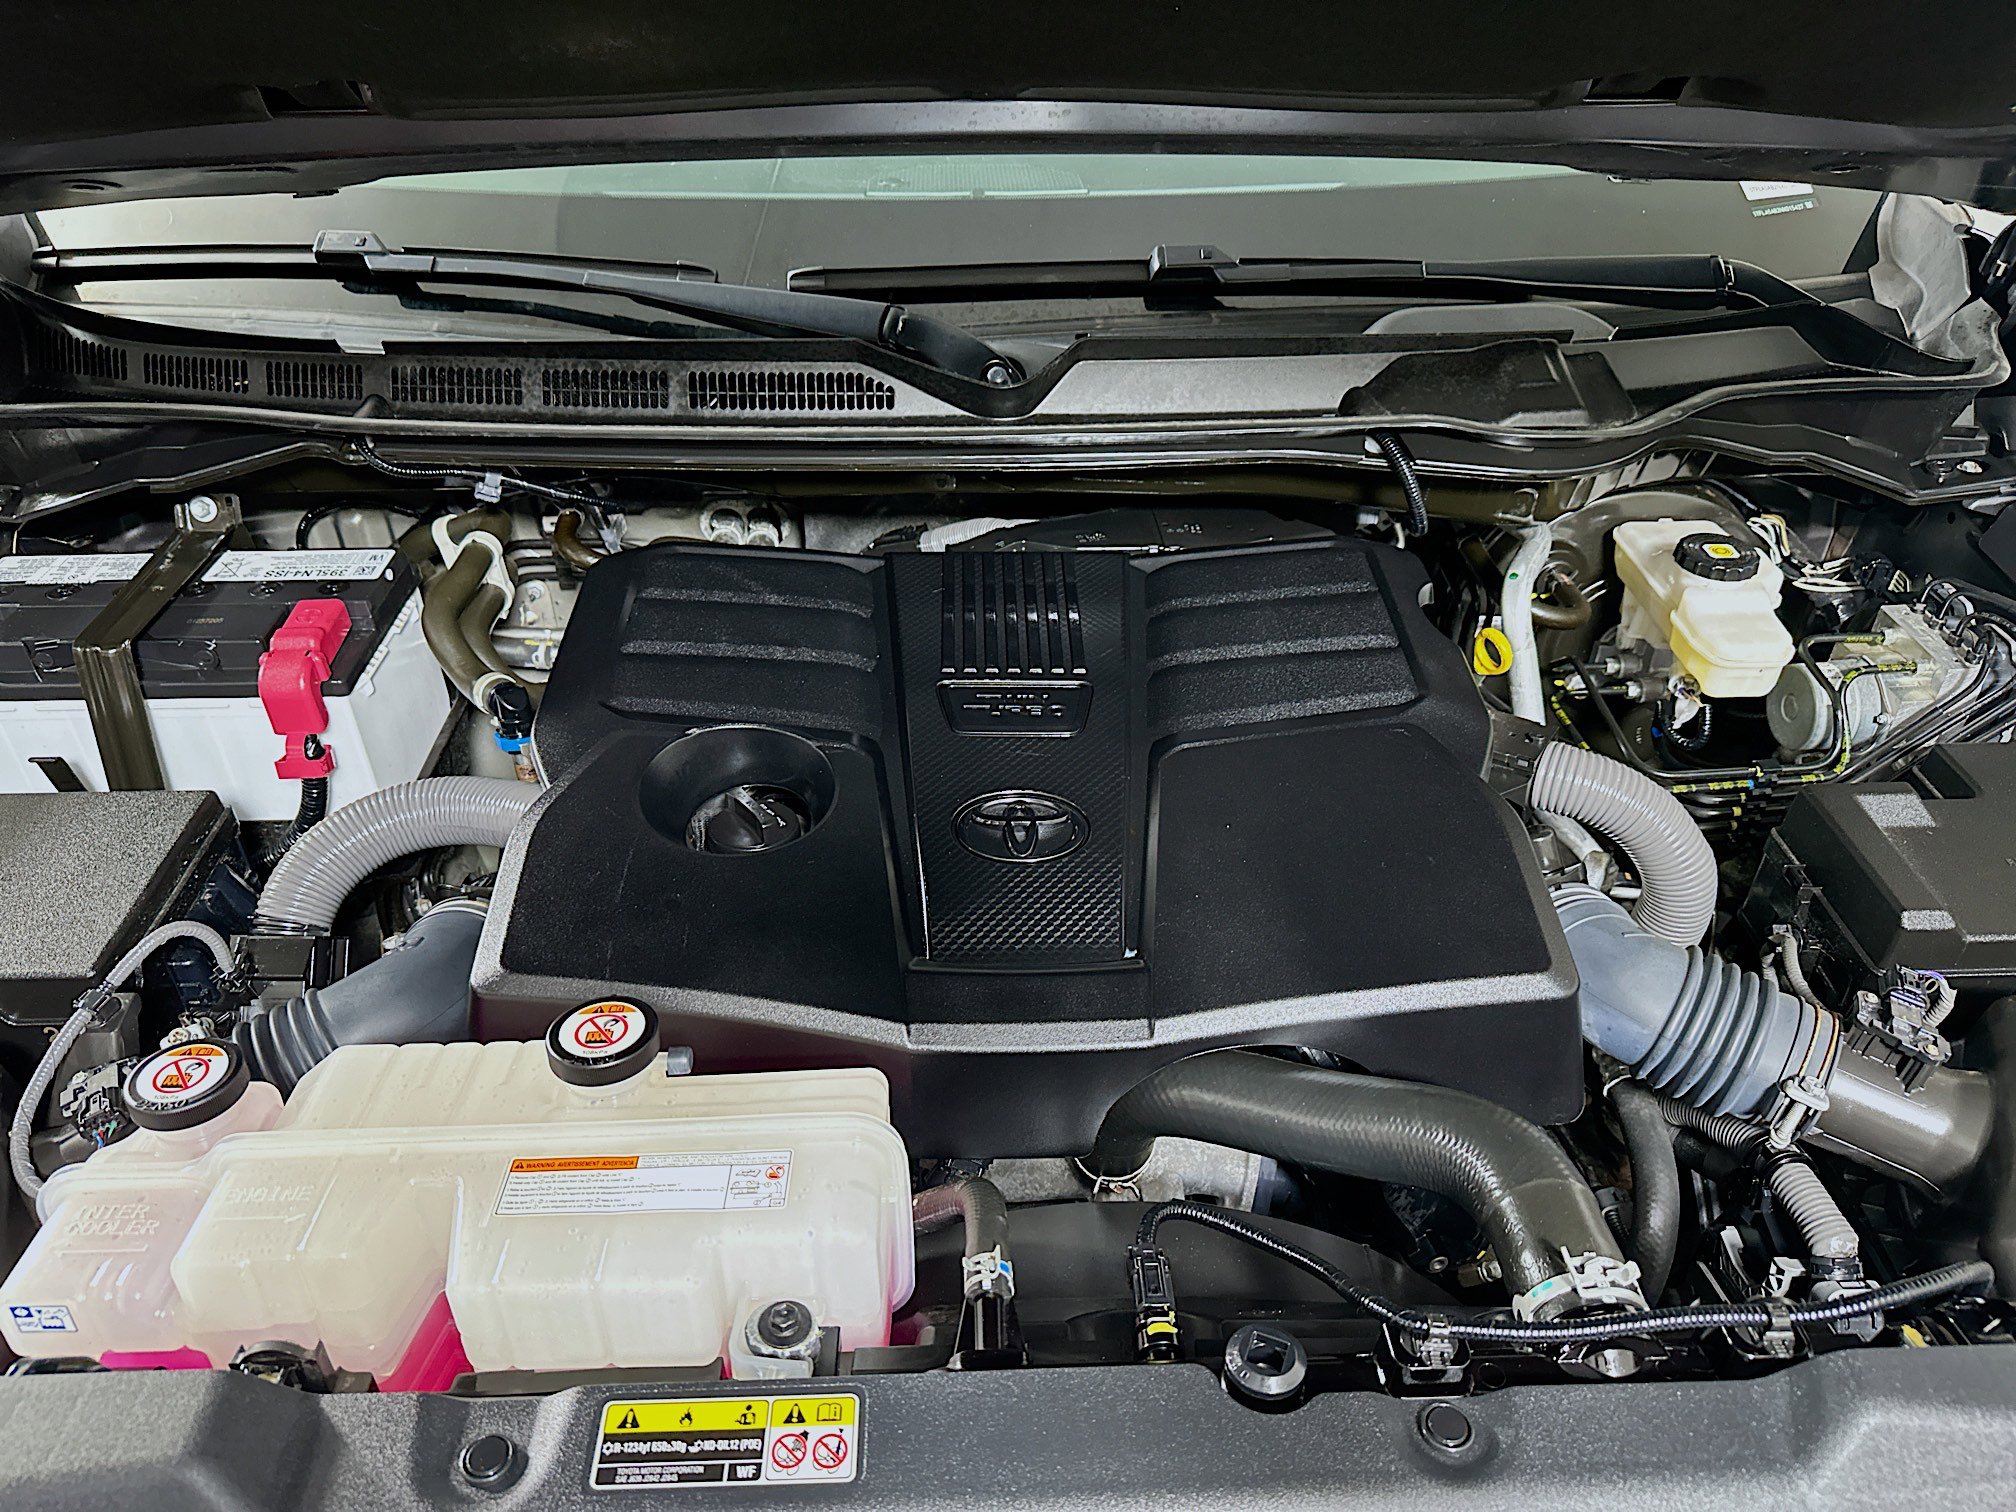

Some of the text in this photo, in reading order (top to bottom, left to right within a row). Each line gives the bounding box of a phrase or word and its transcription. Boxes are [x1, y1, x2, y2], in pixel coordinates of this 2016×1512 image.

[526, 1161, 555, 1169] WARNING
[225, 1184, 315, 1203] ENGINE
[76, 1202, 151, 1220] INTER
[65, 1219, 160, 1237] COOLER
[617, 1465, 705, 1475] TOYOTA MOTOR CORPORATION
[736, 1464, 757, 1479] WF
